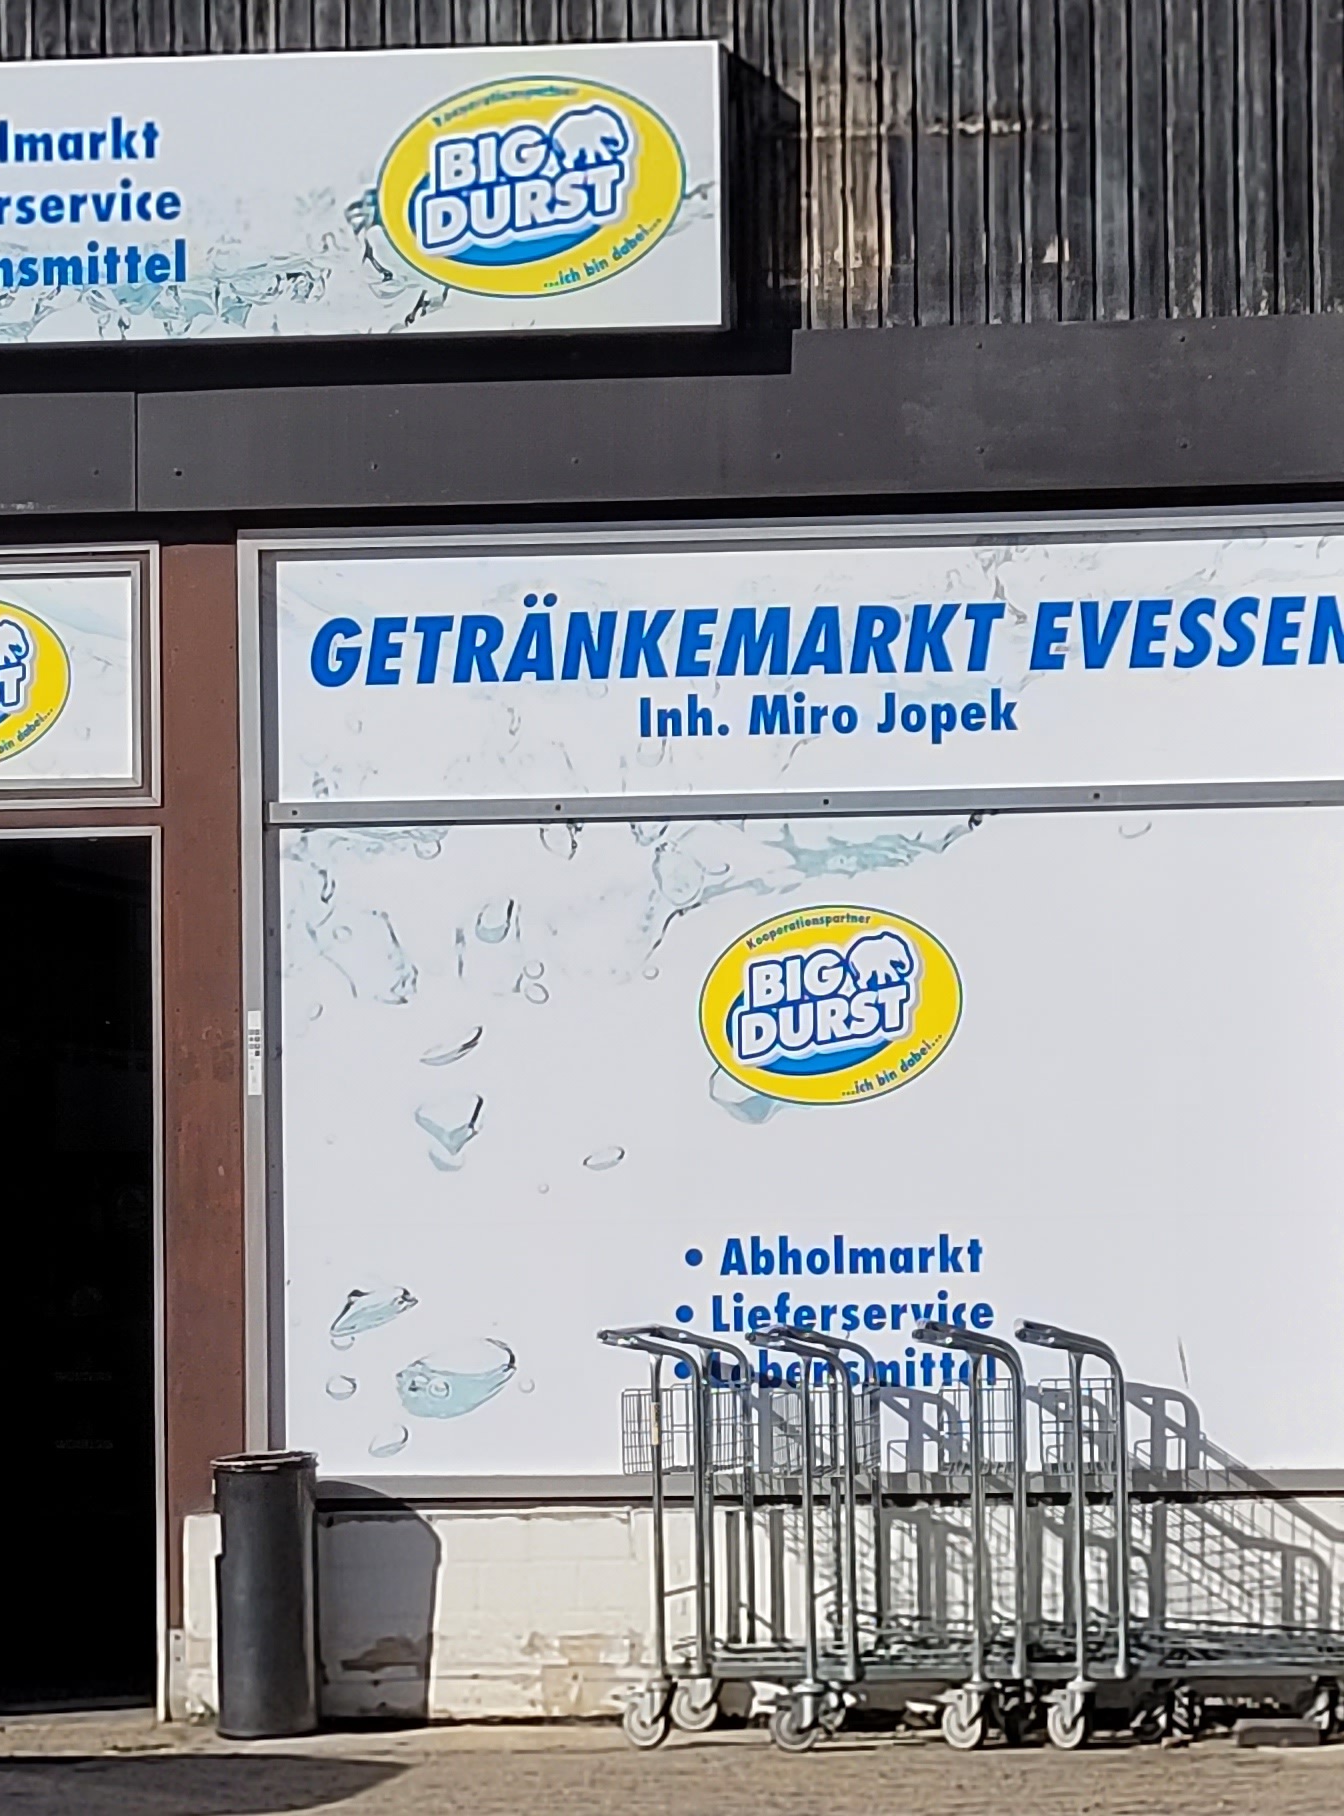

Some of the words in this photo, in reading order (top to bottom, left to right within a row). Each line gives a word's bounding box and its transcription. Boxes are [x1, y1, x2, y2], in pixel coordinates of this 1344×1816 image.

[437, 128, 549, 191] BIG
[425, 164, 621, 247] DURST
[582, 258, 609, 277] bin
[310, 593, 1006, 688] GETRÄNKEMARKT
[639, 694, 729, 738] Inh.
[748, 691, 859, 735] Miro
[877, 688, 1017, 744] Jopek
[745, 912, 872, 950] Kooperationspartner
[751, 951, 846, 1007] BIG
[740, 985, 908, 1057] DURST
[877, 1069, 898, 1087] bin
[720, 1233, 984, 1276] Abholmarkt
[712, 1290, 994, 1333] Lieferservice
